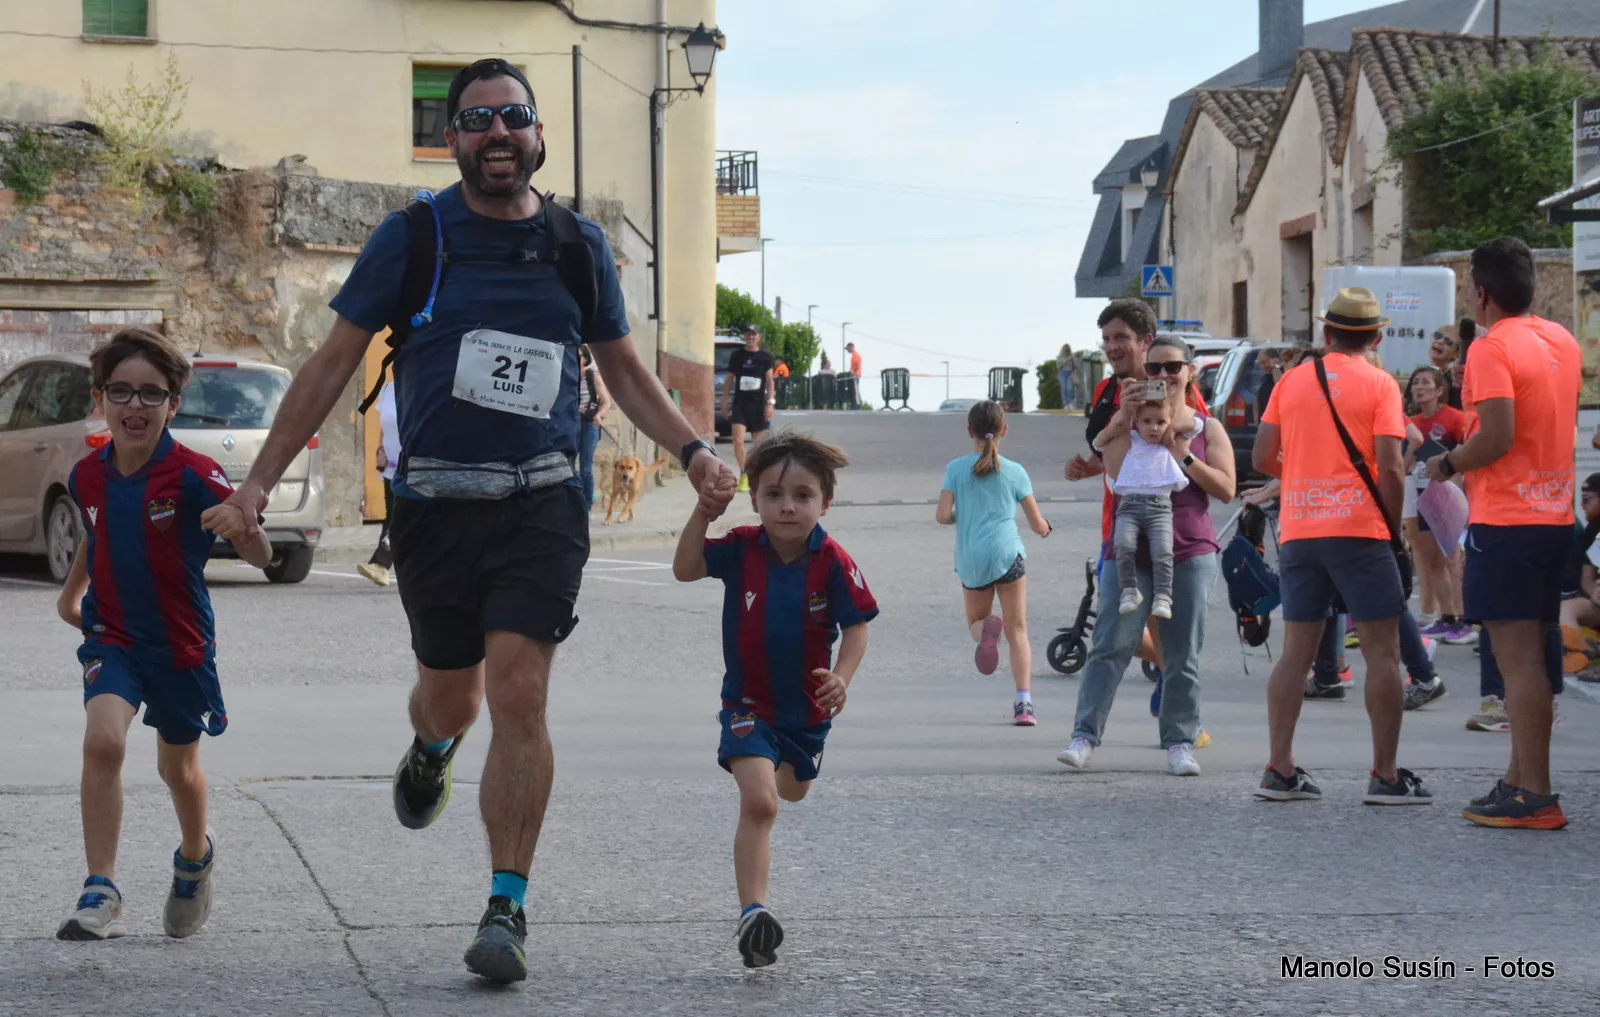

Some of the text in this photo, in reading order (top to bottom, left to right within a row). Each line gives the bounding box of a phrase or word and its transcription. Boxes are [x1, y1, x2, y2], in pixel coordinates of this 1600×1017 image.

[513, 345, 522, 354] LA
[491, 355, 528, 383] 21
[493, 380, 524, 395] LUIS
